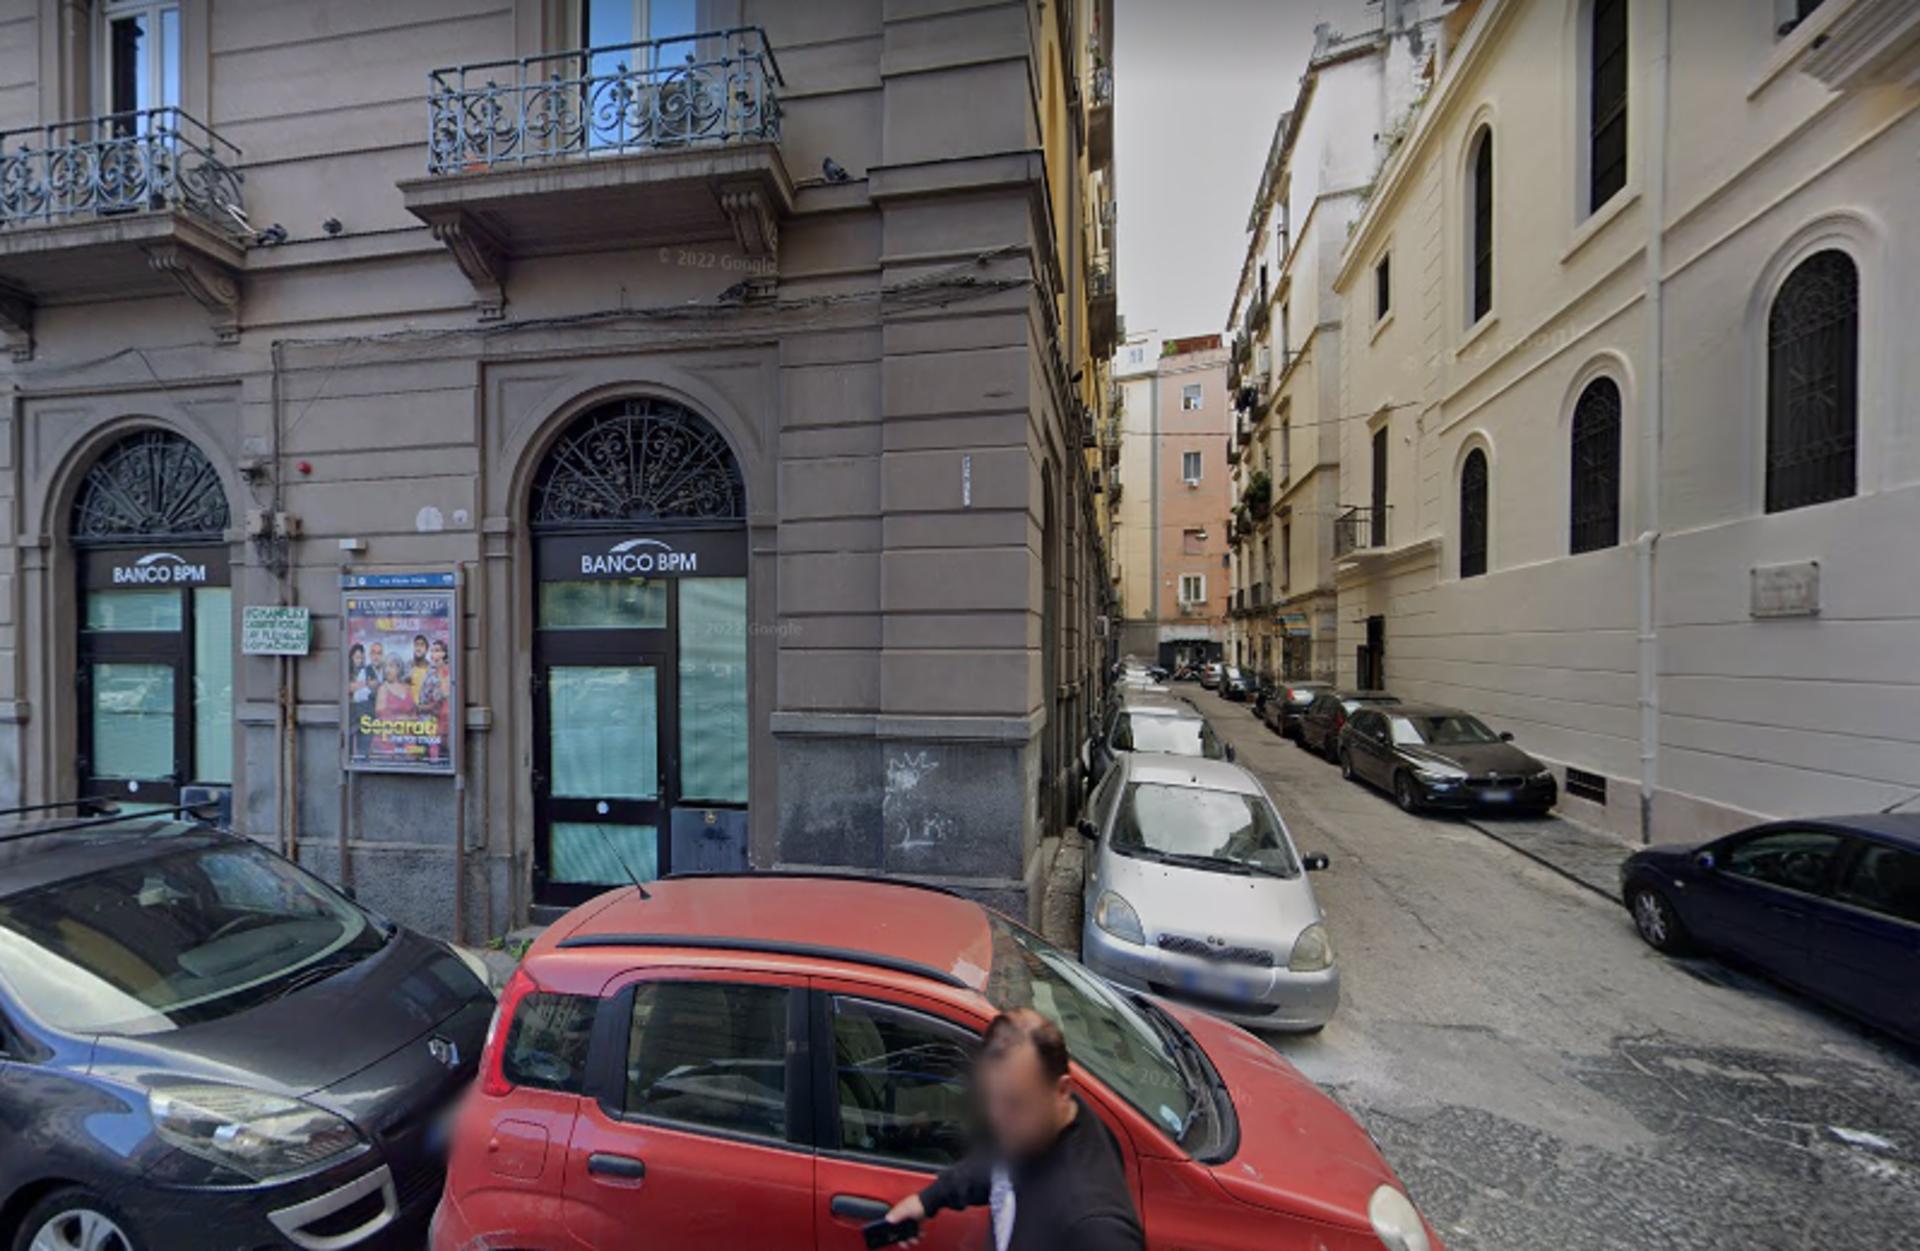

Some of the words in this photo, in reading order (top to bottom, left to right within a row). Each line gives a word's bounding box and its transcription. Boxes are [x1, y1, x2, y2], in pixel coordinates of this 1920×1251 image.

[581, 554, 653, 573] BANCO
[658, 552, 697, 571] BPM
[112, 565, 171, 583] BANCO
[173, 564, 205, 582] BPM
[360, 714, 438, 742] Separati
